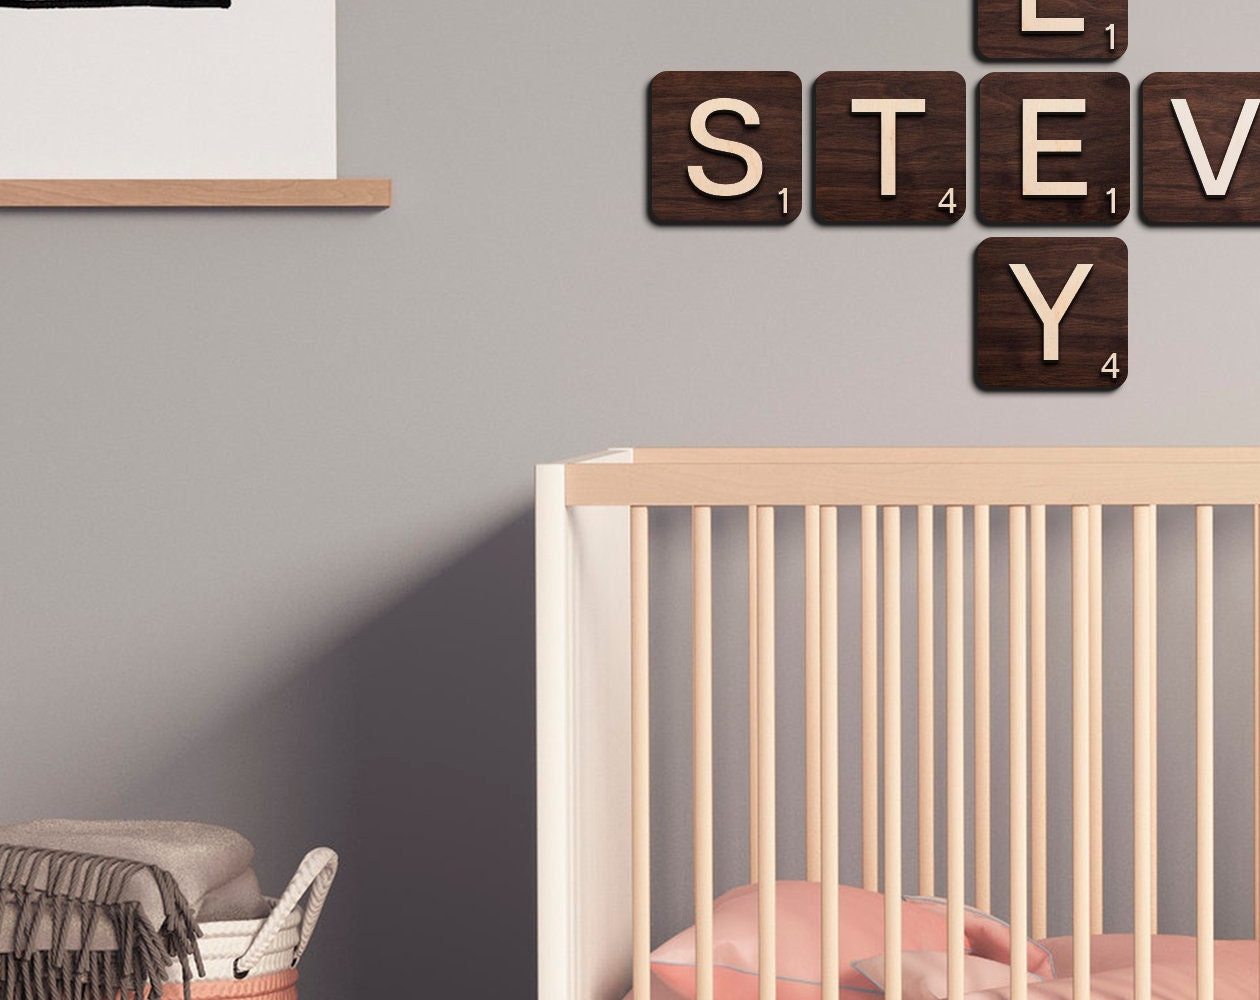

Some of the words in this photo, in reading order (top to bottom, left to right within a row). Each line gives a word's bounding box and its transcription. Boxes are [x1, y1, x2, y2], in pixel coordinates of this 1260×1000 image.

[1104, 23, 1115, 50] 1
[777, 187, 788, 214] 1
[937, 187, 956, 214] 4
[1105, 187, 1116, 214] 1
[1100, 352, 1119, 379] 4
